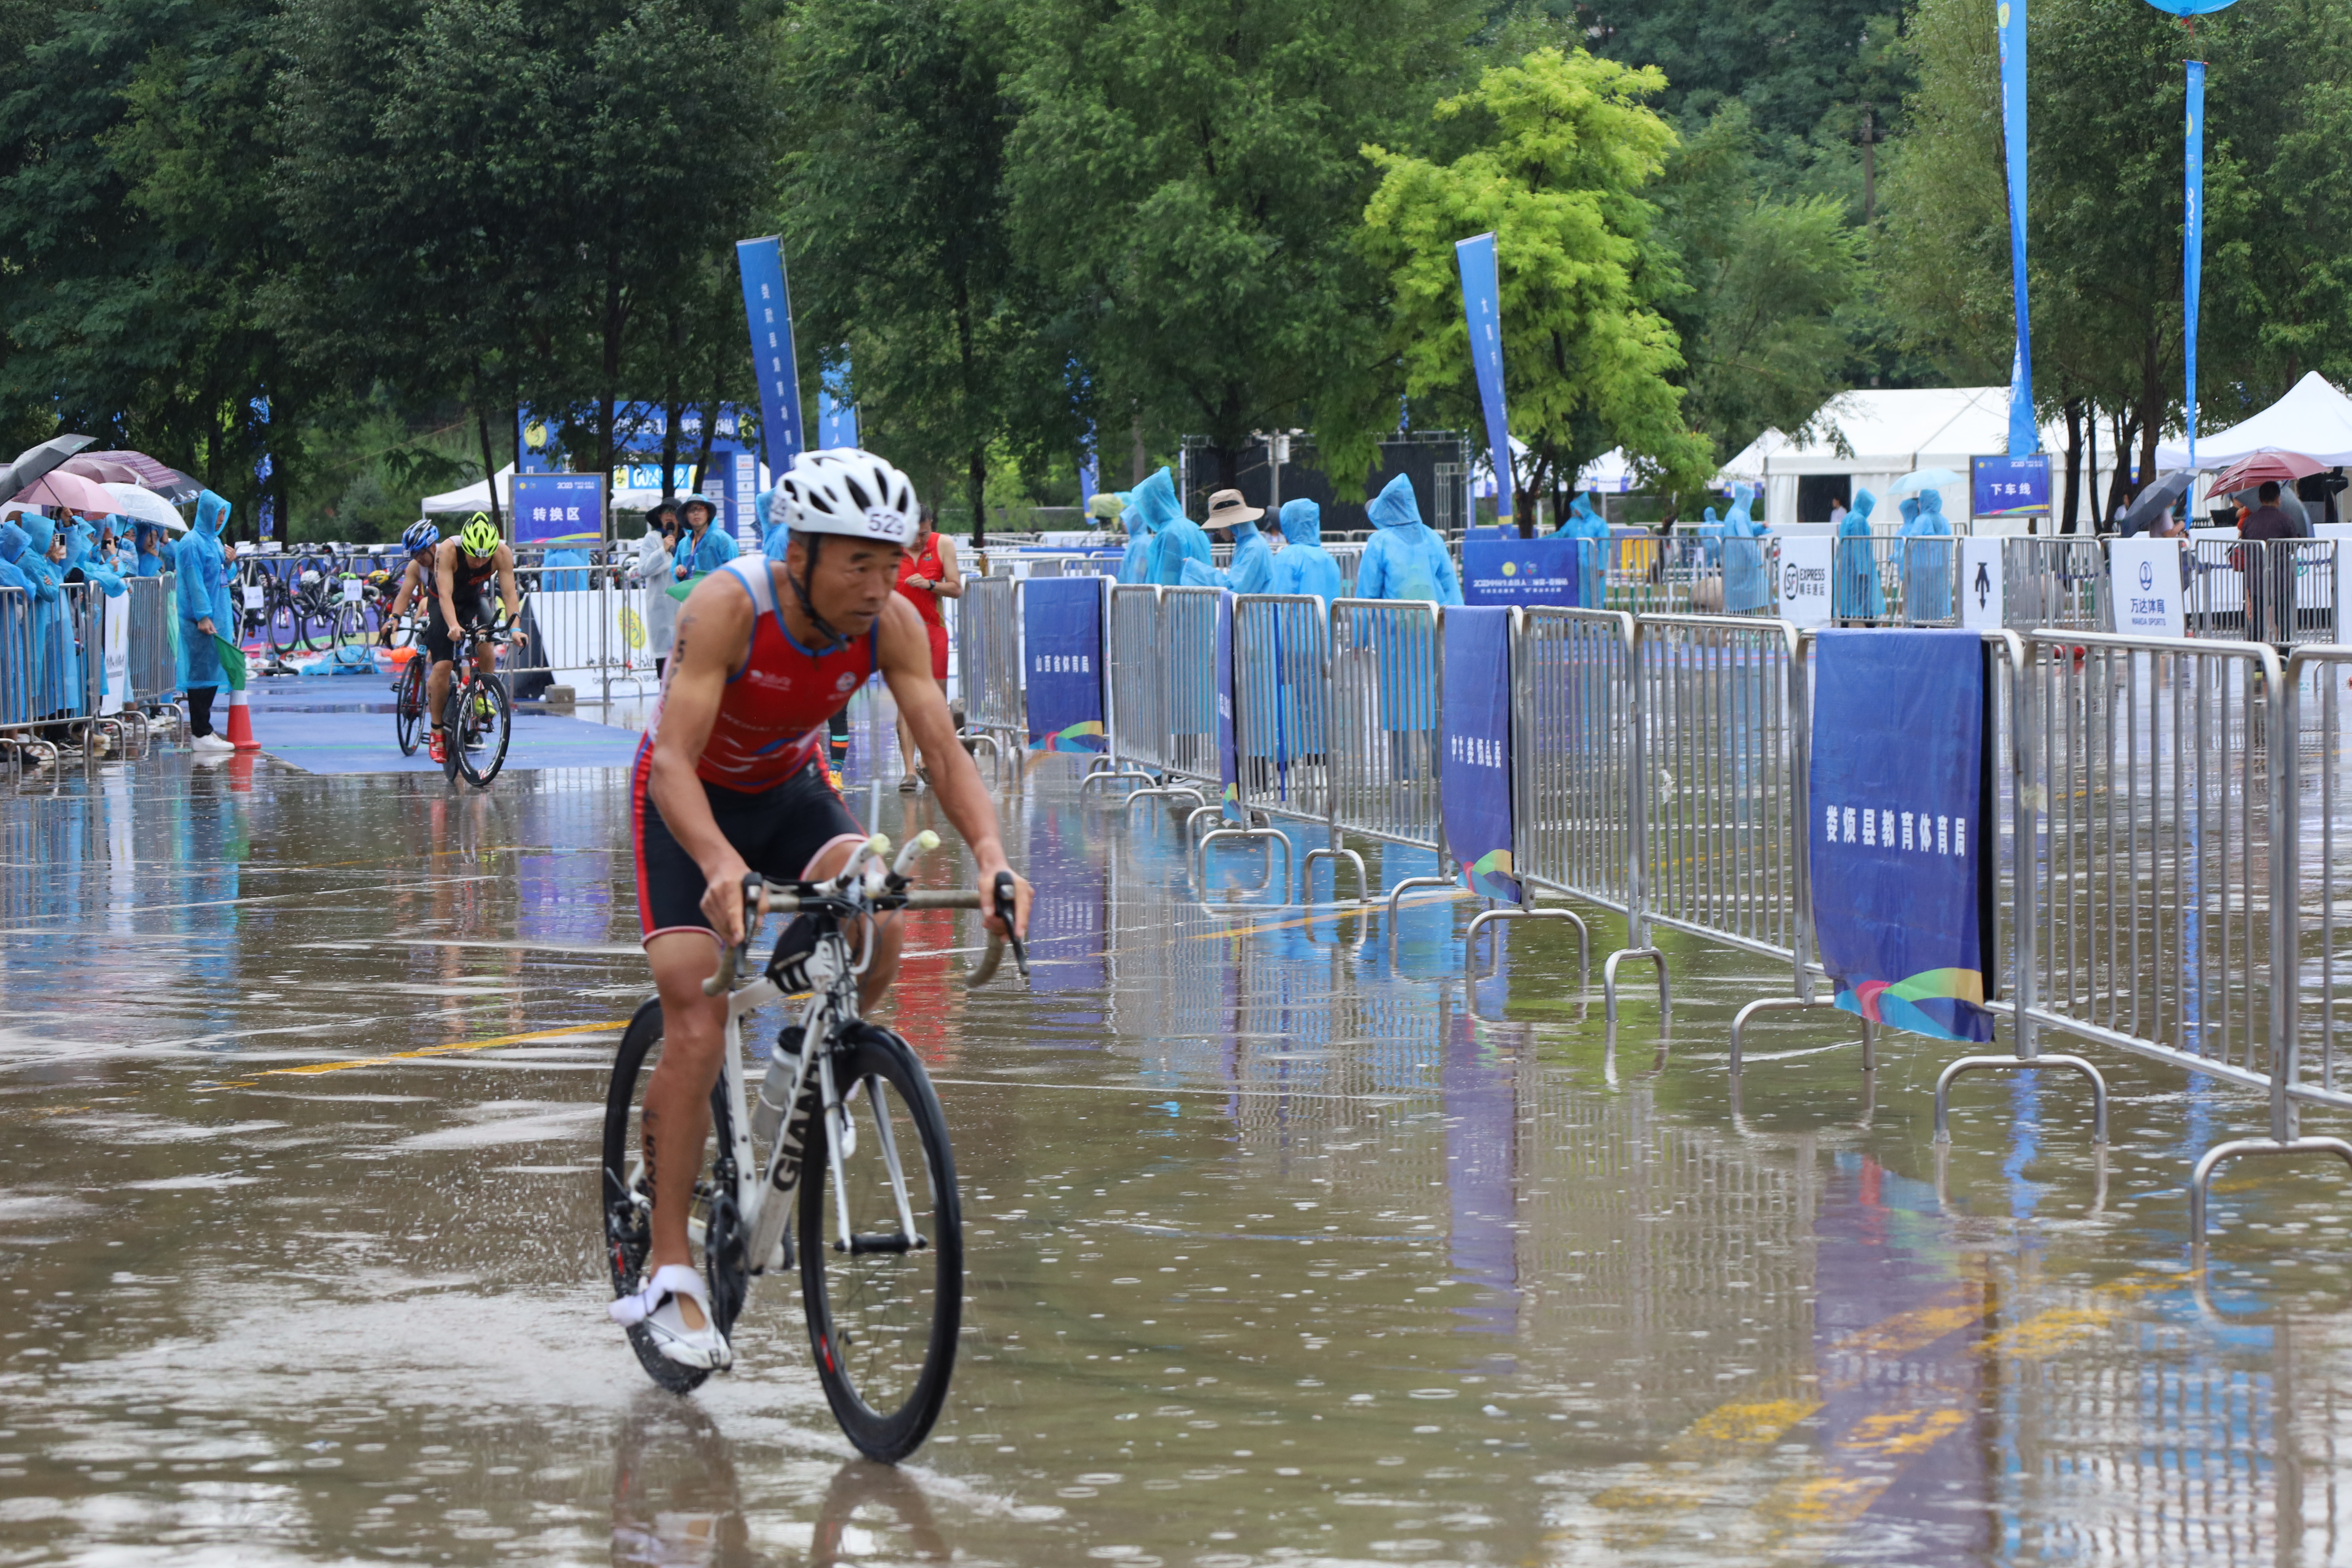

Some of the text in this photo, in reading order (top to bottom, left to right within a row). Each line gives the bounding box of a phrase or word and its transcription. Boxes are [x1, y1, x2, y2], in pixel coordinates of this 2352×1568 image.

[1991, 483, 2031, 496] 下车线
[533, 507, 580, 522] 转换区
[1787, 573, 1796, 590] SF
[1799, 568, 1825, 581] EXPRESS
[2130, 598, 2165, 614] 万达体育
[1036, 655, 1089, 673] 山西省体育局
[1452, 734, 1501, 769] 中共娄烦县委
[1826, 805, 1965, 857] 娄烦县教育体育局
